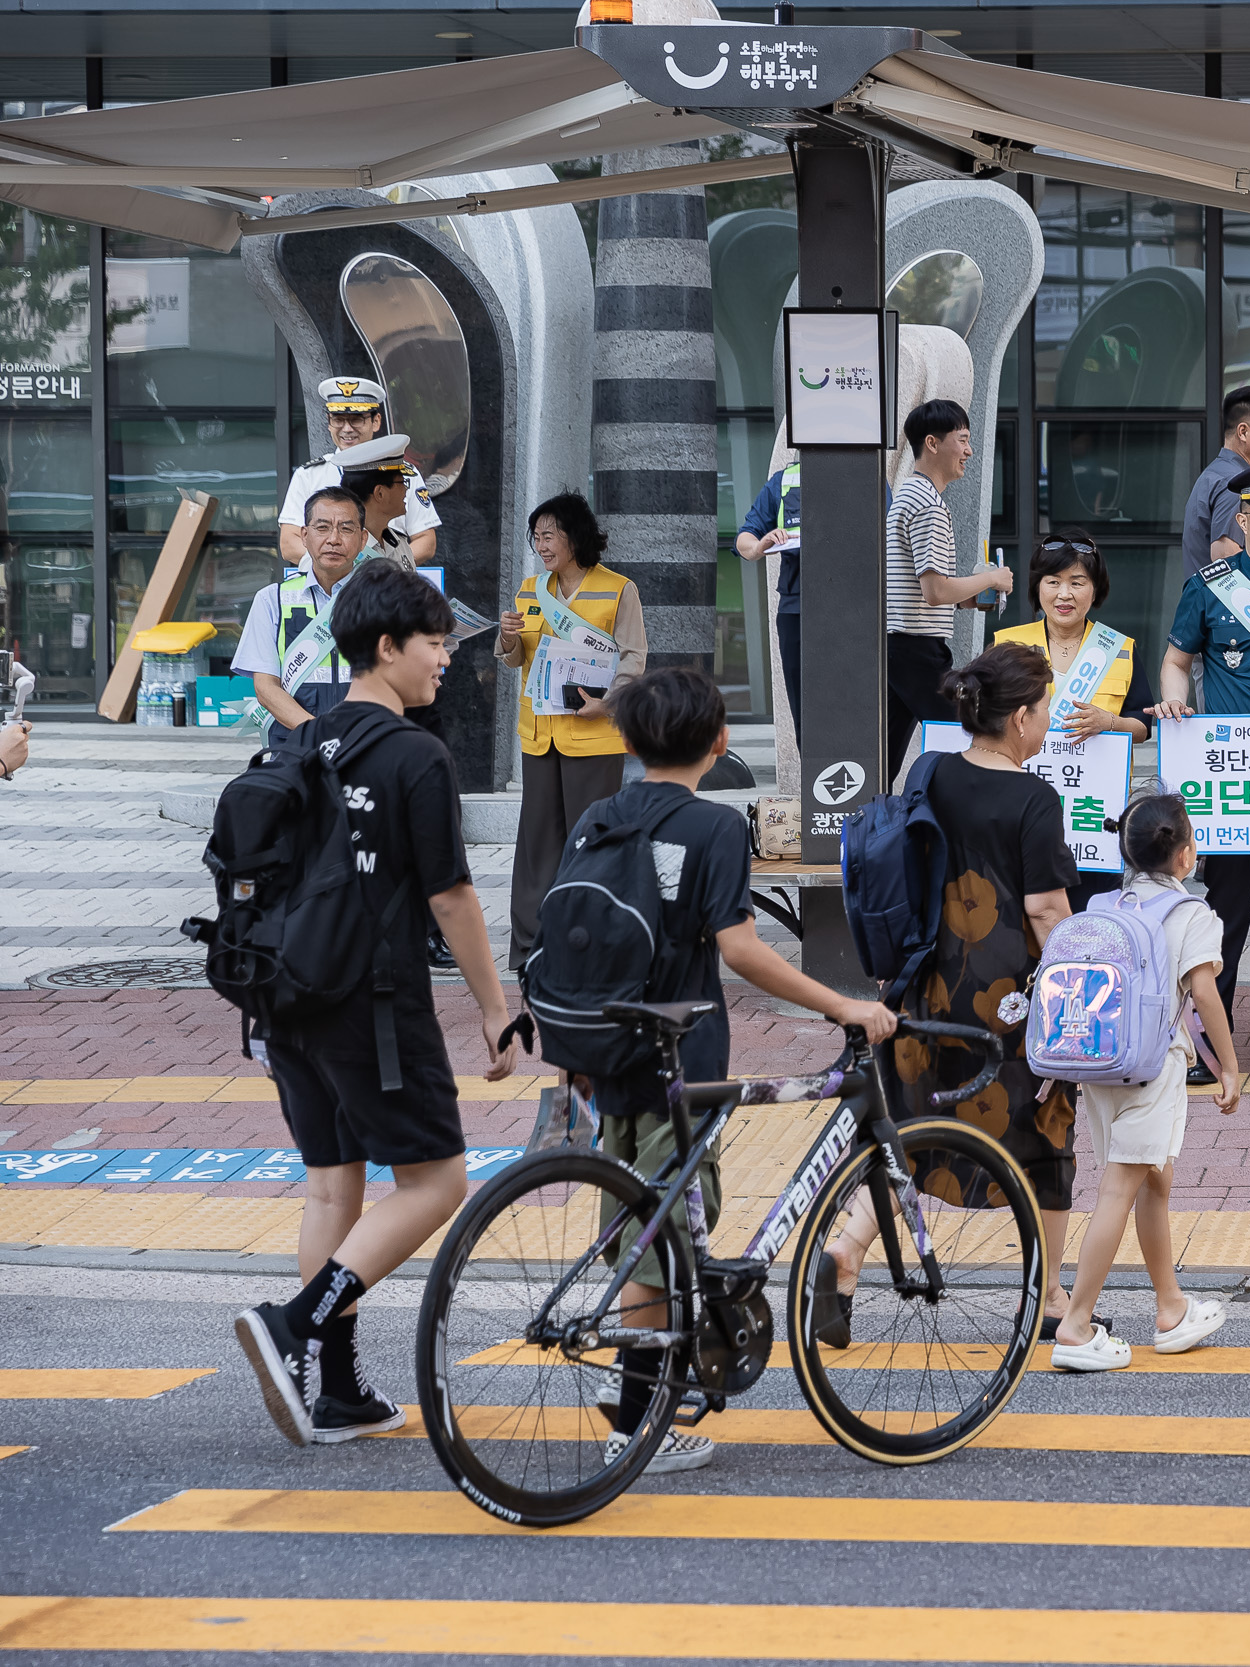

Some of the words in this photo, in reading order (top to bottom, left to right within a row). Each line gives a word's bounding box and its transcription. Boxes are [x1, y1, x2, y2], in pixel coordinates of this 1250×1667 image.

[740, 62, 818, 91] 행복광진
[835, 377, 872, 390] 행복광진
[1069, 662, 1098, 699] 아이
[1050, 741, 1085, 756] 캠페인
[1062, 765, 1084, 788] 앞
[812, 812, 856, 827] 광진
[1060, 795, 1106, 833] 춤
[811, 827, 842, 835] GWANG
[1194, 827, 1210, 845] 이
[1216, 827, 1249, 846] 먼저
[1069, 843, 1105, 862] 세요.
[1060, 987, 1090, 1037] LA
[141, 1151, 303, 1164] 려서!
[105, 1166, 293, 1181] 전거는
